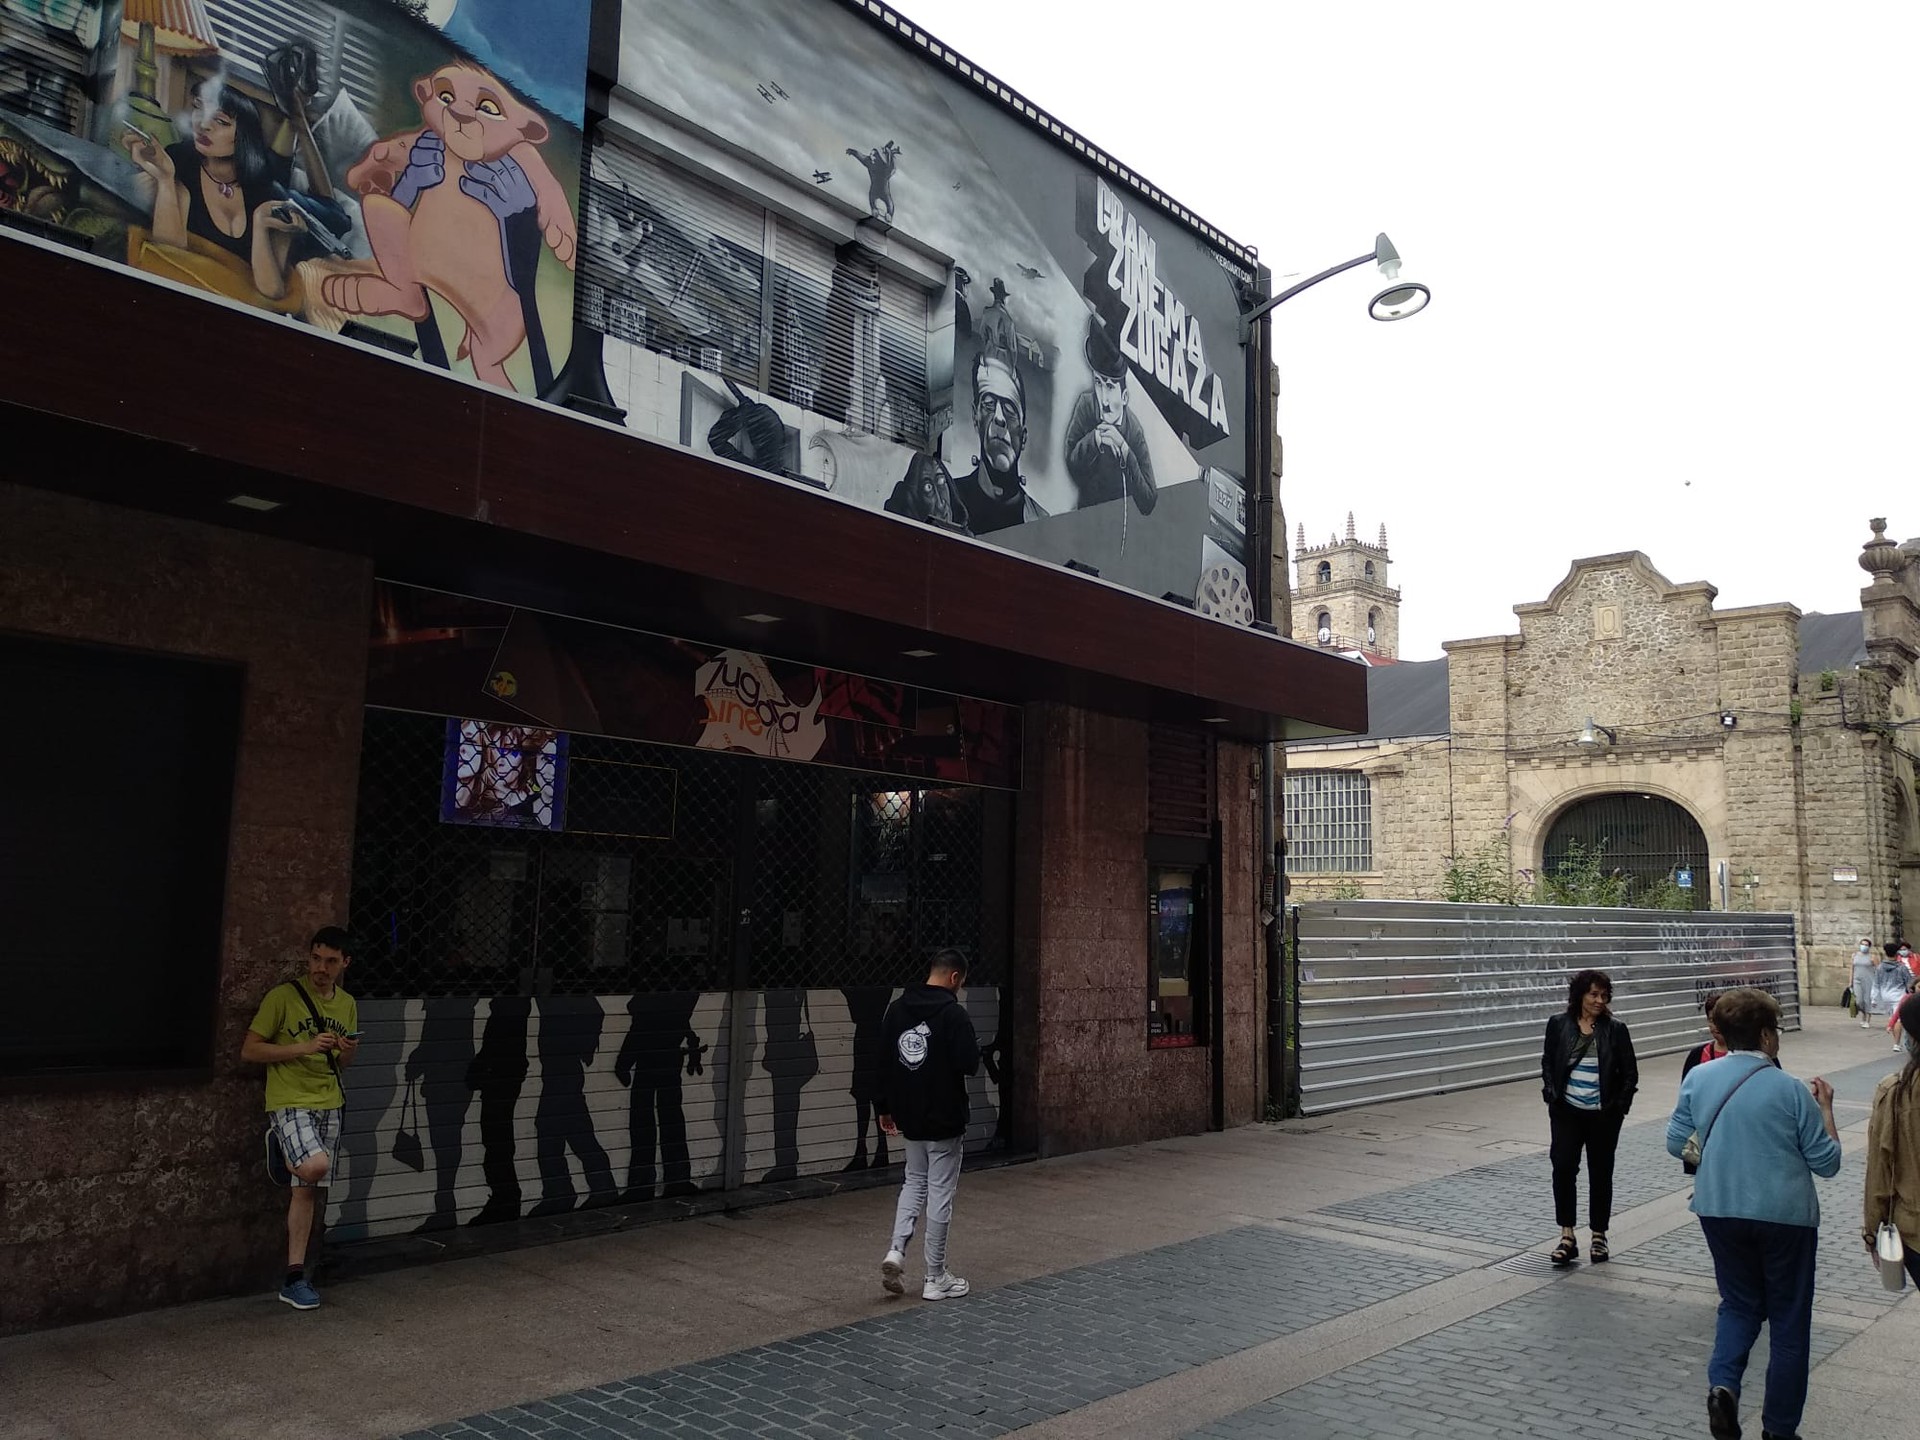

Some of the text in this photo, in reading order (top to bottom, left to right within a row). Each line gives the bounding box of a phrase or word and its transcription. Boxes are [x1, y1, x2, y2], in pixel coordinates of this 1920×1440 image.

[1096, 176, 1156, 278] GRAN
[1108, 248, 1206, 364] ZINEMA
[1120, 300, 1229, 437] ZUGAZA
